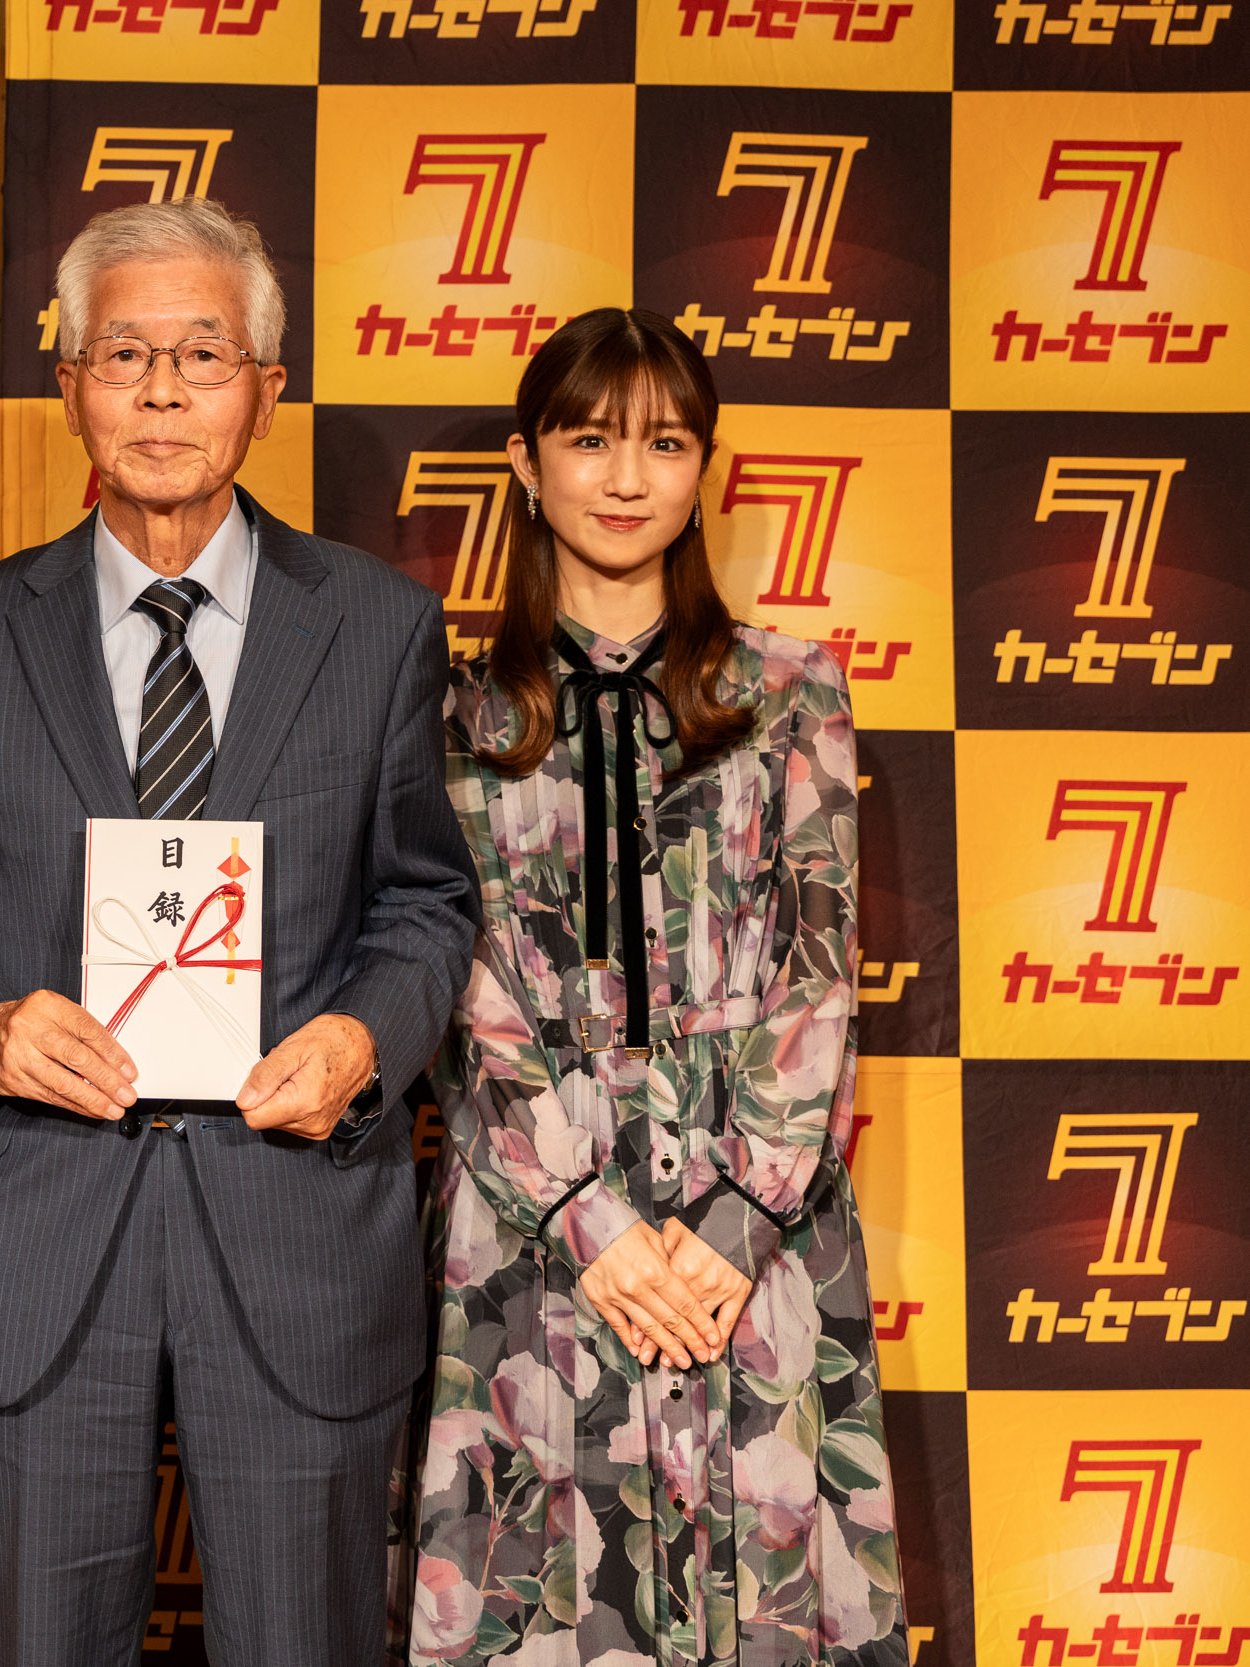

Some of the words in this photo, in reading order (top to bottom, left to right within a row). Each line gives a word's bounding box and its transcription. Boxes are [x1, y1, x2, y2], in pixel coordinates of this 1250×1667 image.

[672, 303, 911, 362] カーセブン
[991, 310, 1229, 364] カーセブン
[993, 629, 1233, 685] カーセブン
[147, 837, 185, 928] 目録
[1001, 951, 1240, 1006] カーセブン
[1006, 1287, 1247, 1343] カーセブン
[1017, 1613, 1250, 1667] カーセブン
